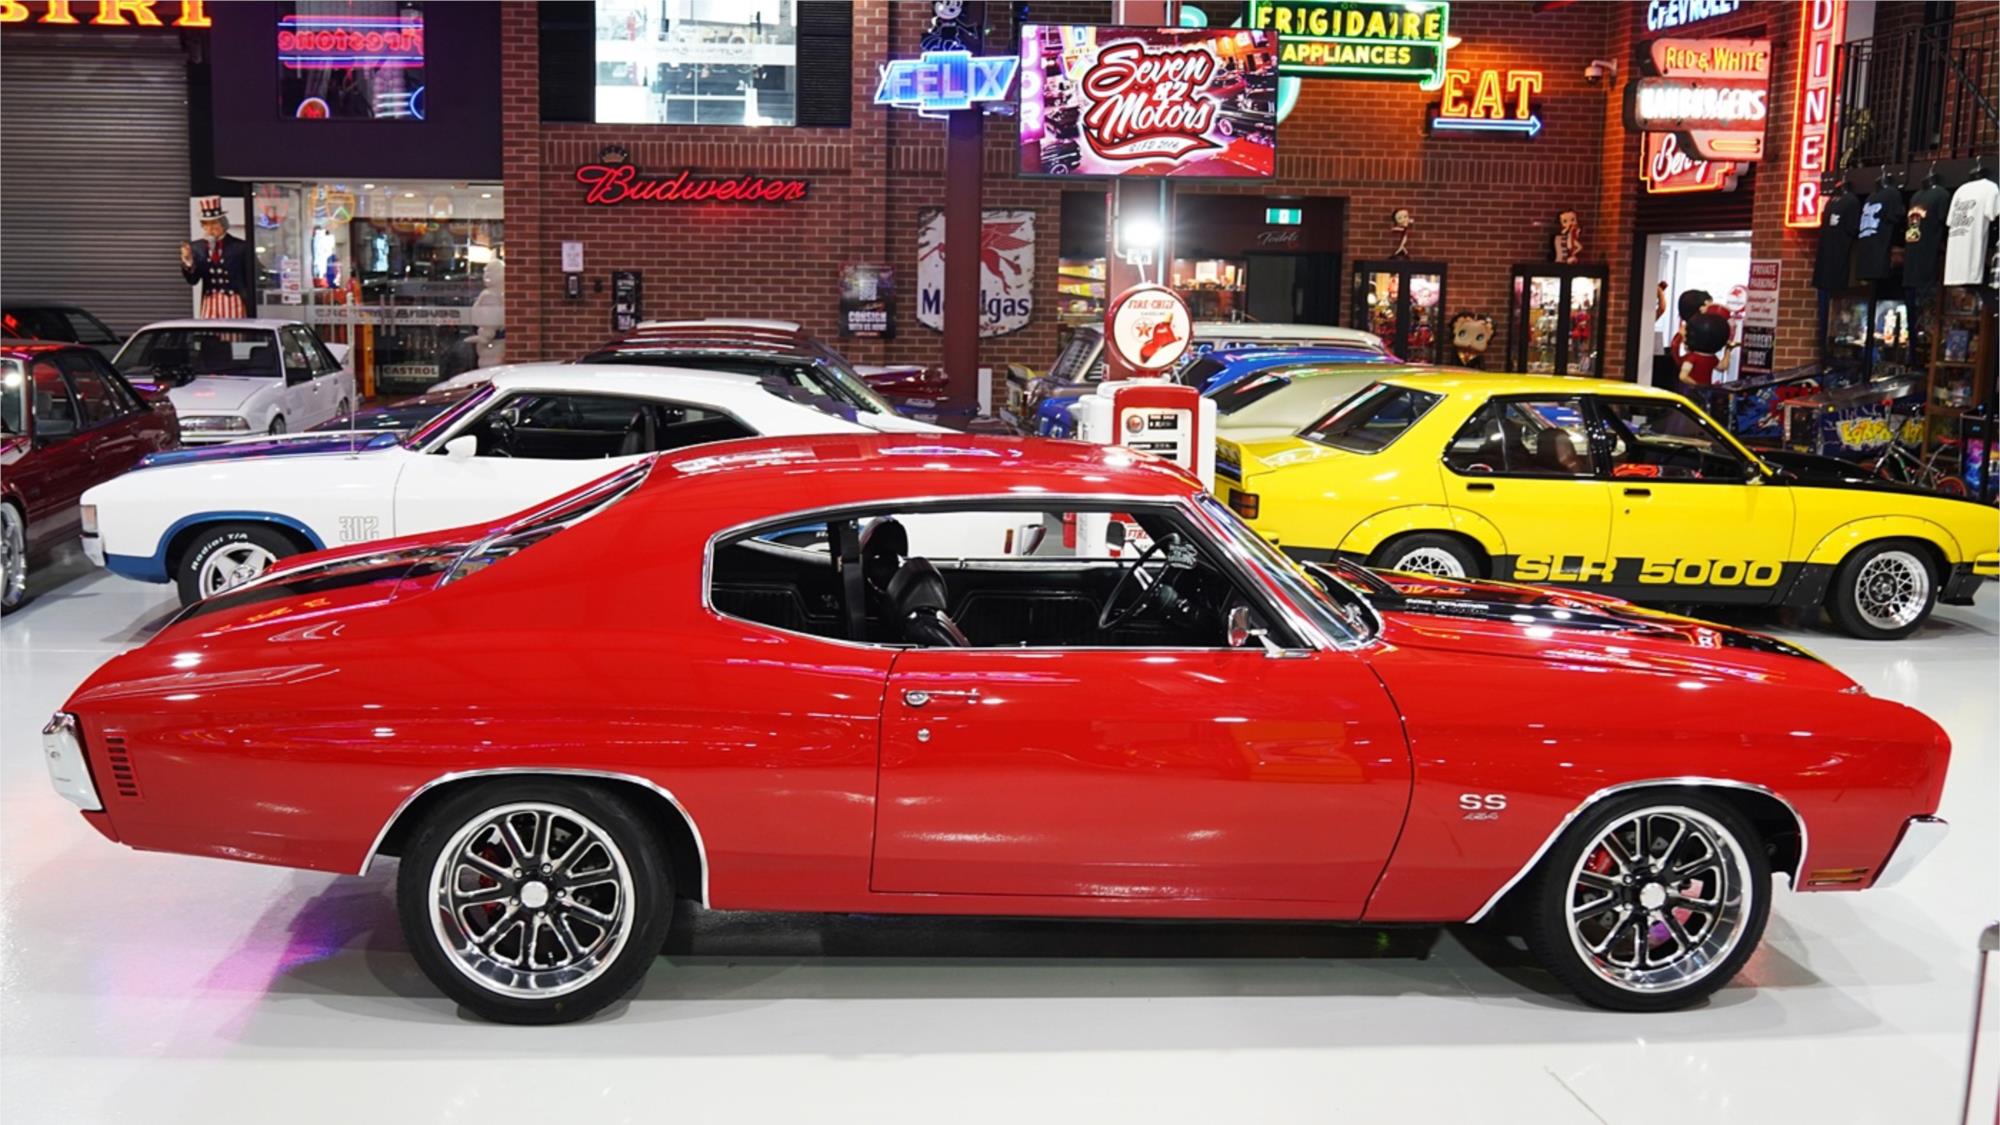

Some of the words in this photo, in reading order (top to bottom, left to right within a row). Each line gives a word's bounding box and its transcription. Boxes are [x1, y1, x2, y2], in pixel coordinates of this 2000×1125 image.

[1257, 7, 1441, 40] FRIGIDAIRE
[1281, 43, 1411, 64] APPLIANCES
[1666, 47, 1696, 69] RED
[1697, 54, 1711, 72] &
[1711, 47, 1765, 71] WHITE
[892, 62, 1002, 100] FELIX
[1088, 49, 1208, 98] Seven
[1151, 81, 1188, 101] 82
[1442, 69, 1542, 119] EAT
[1639, 87, 1767, 121] HAMBURGERS
[1797, 0, 1832, 215] DINER
[1091, 92, 1211, 142] Motors
[576, 165, 807, 205] Budweiser
[922, 288, 1030, 324] Mlgas
[383, 366, 439, 377] CASTROL
[339, 515, 380, 542] 302
[191, 536, 224, 570] Radial
[227, 532, 248, 540] T/A
[1513, 554, 1618, 583] SLR
[1638, 557, 1783, 587] 5000
[1460, 793, 1507, 810] SS
